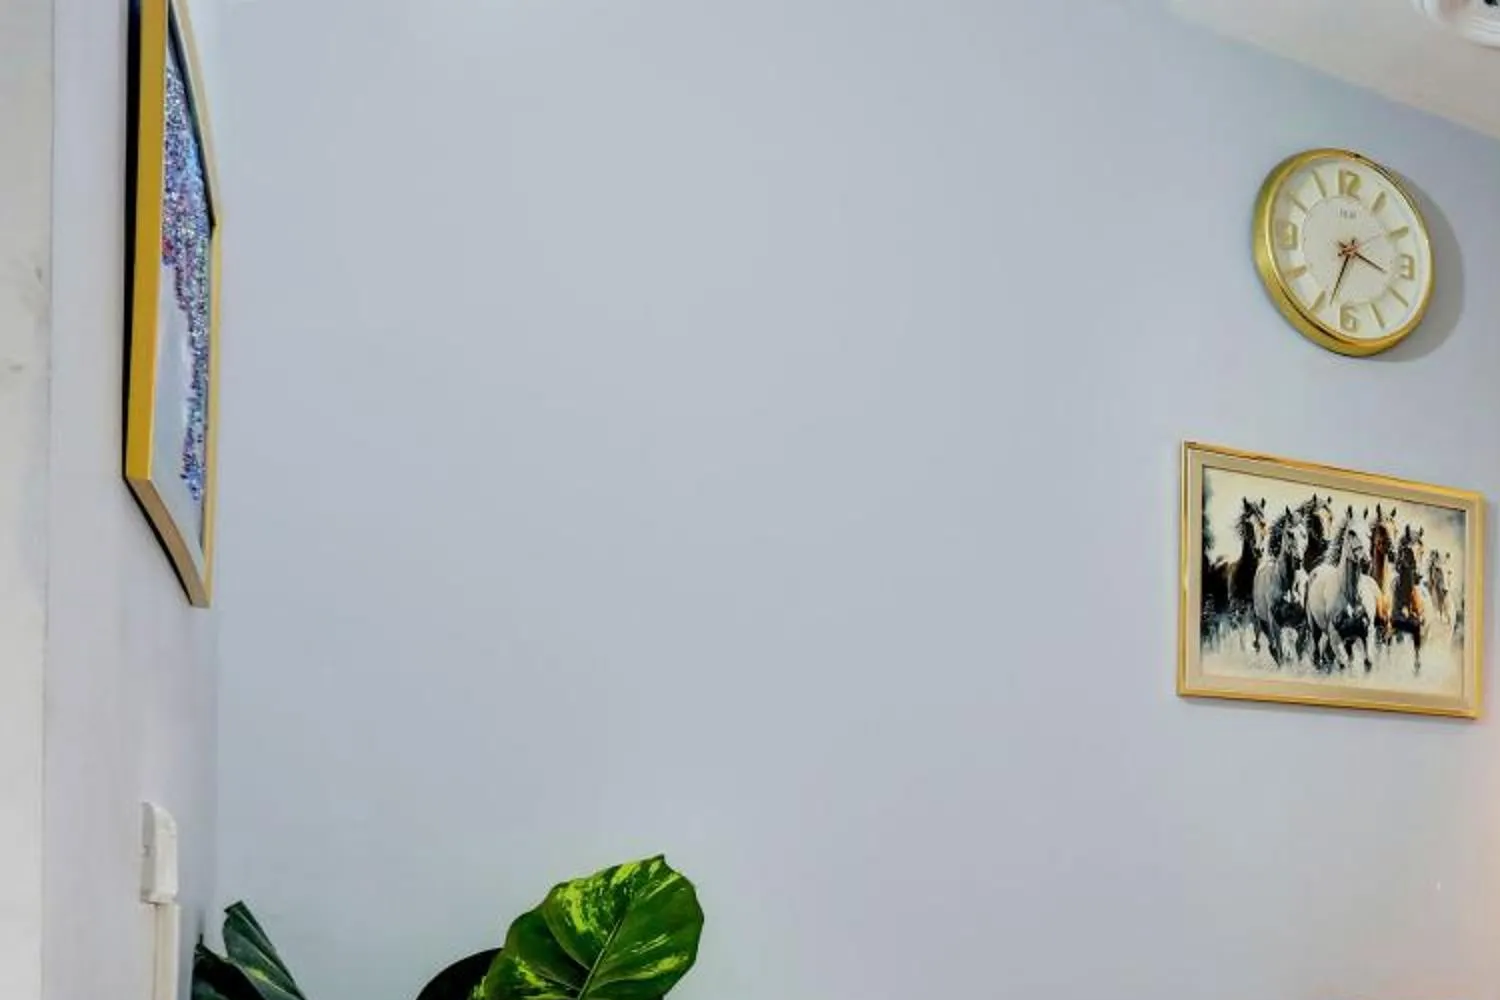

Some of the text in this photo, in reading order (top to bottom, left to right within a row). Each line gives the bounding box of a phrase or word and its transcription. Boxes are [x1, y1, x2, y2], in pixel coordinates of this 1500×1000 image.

[1337, 168, 1361, 201] 12
[1399, 253, 1416, 281] 3
[1339, 303, 1359, 332] 6
